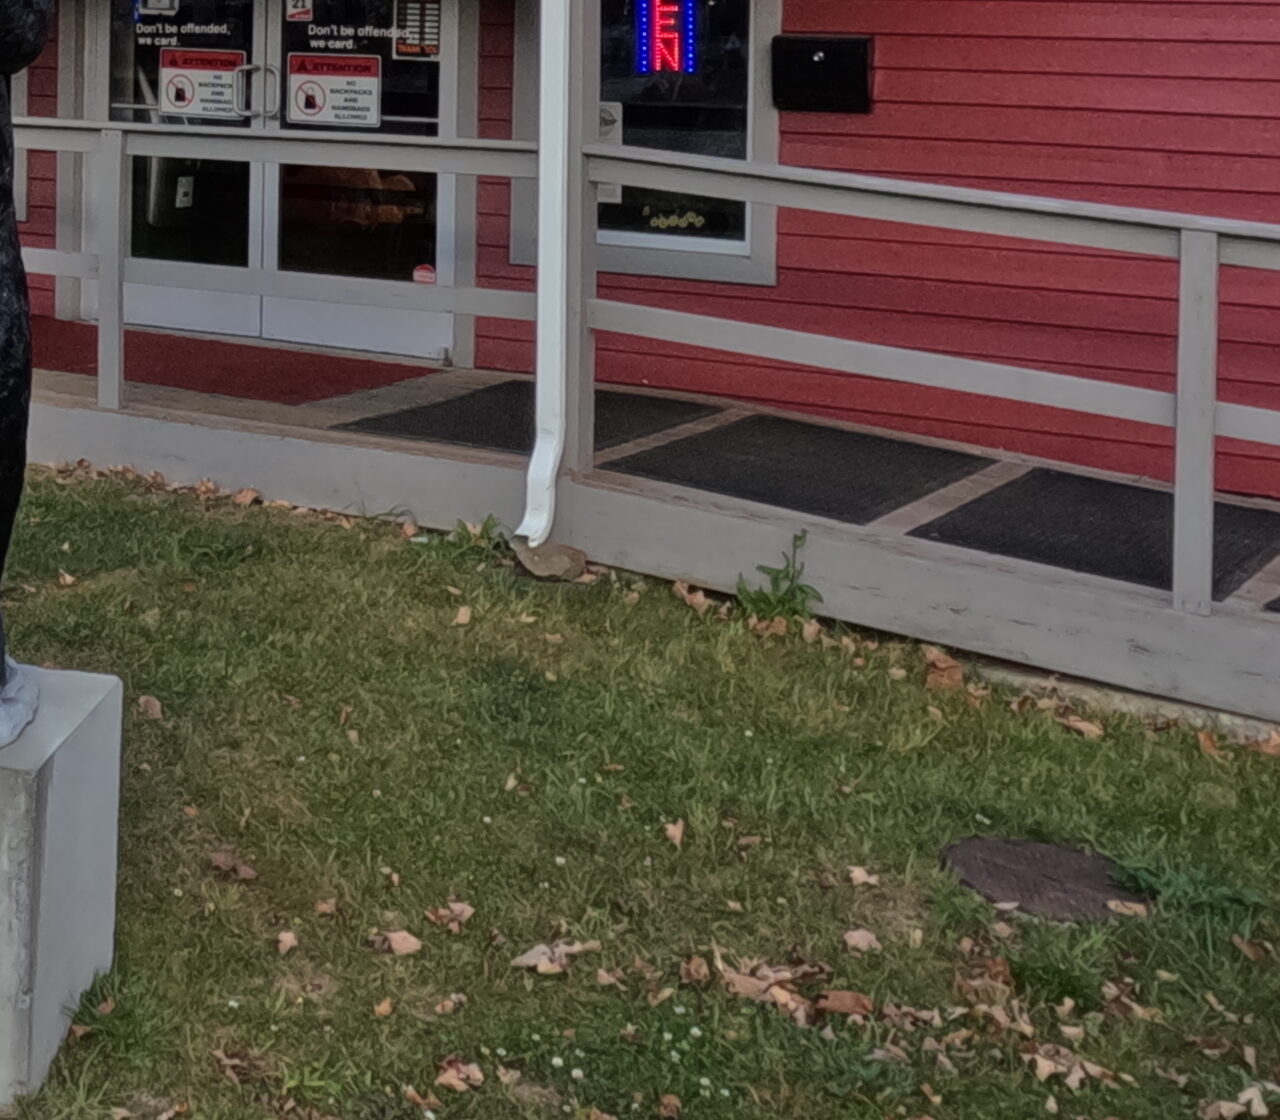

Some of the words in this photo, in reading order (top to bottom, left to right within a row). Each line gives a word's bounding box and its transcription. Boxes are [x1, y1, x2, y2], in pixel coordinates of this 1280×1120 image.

[136, 23, 163, 34] Don't
[165, 23, 177, 34] be
[180, 23, 231, 35] offended,
[308, 24, 338, 36] Don't
[340, 25, 355, 37] be
[138, 37, 152, 45] we
[310, 40, 325, 48] we
